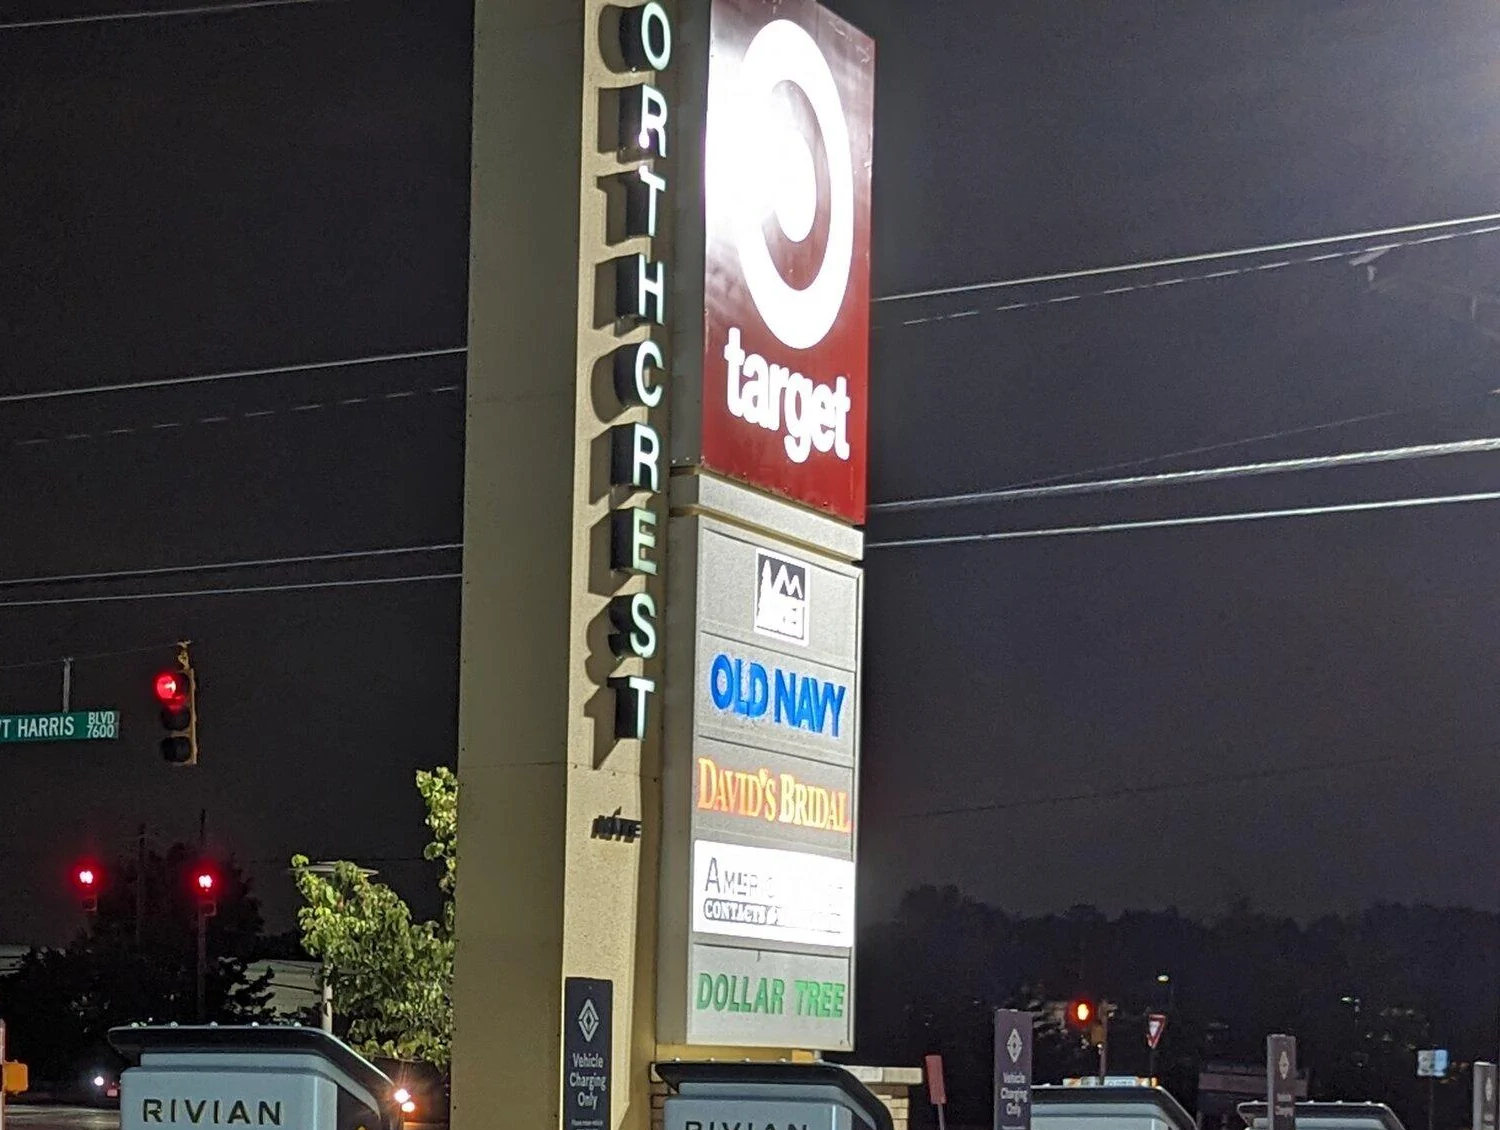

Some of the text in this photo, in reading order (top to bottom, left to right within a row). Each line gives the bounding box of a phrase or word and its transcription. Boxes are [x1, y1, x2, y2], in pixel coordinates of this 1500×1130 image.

[724, 327, 851, 463] target
[710, 653, 846, 738] OLD NAVY
[17, 716, 75, 738] HARRIS
[88, 711, 114, 725] BLVD
[86, 724, 114, 738] 7600
[698, 757, 851, 833] DAVID'S BRIDAL
[697, 972, 846, 1018] DOLLAR TREE
[572, 1053, 604, 1068] Vehicle
[569, 1072, 607, 1091] Charging
[577, 1091, 598, 1110] Only
[143, 1097, 282, 1127] RIVIAN
